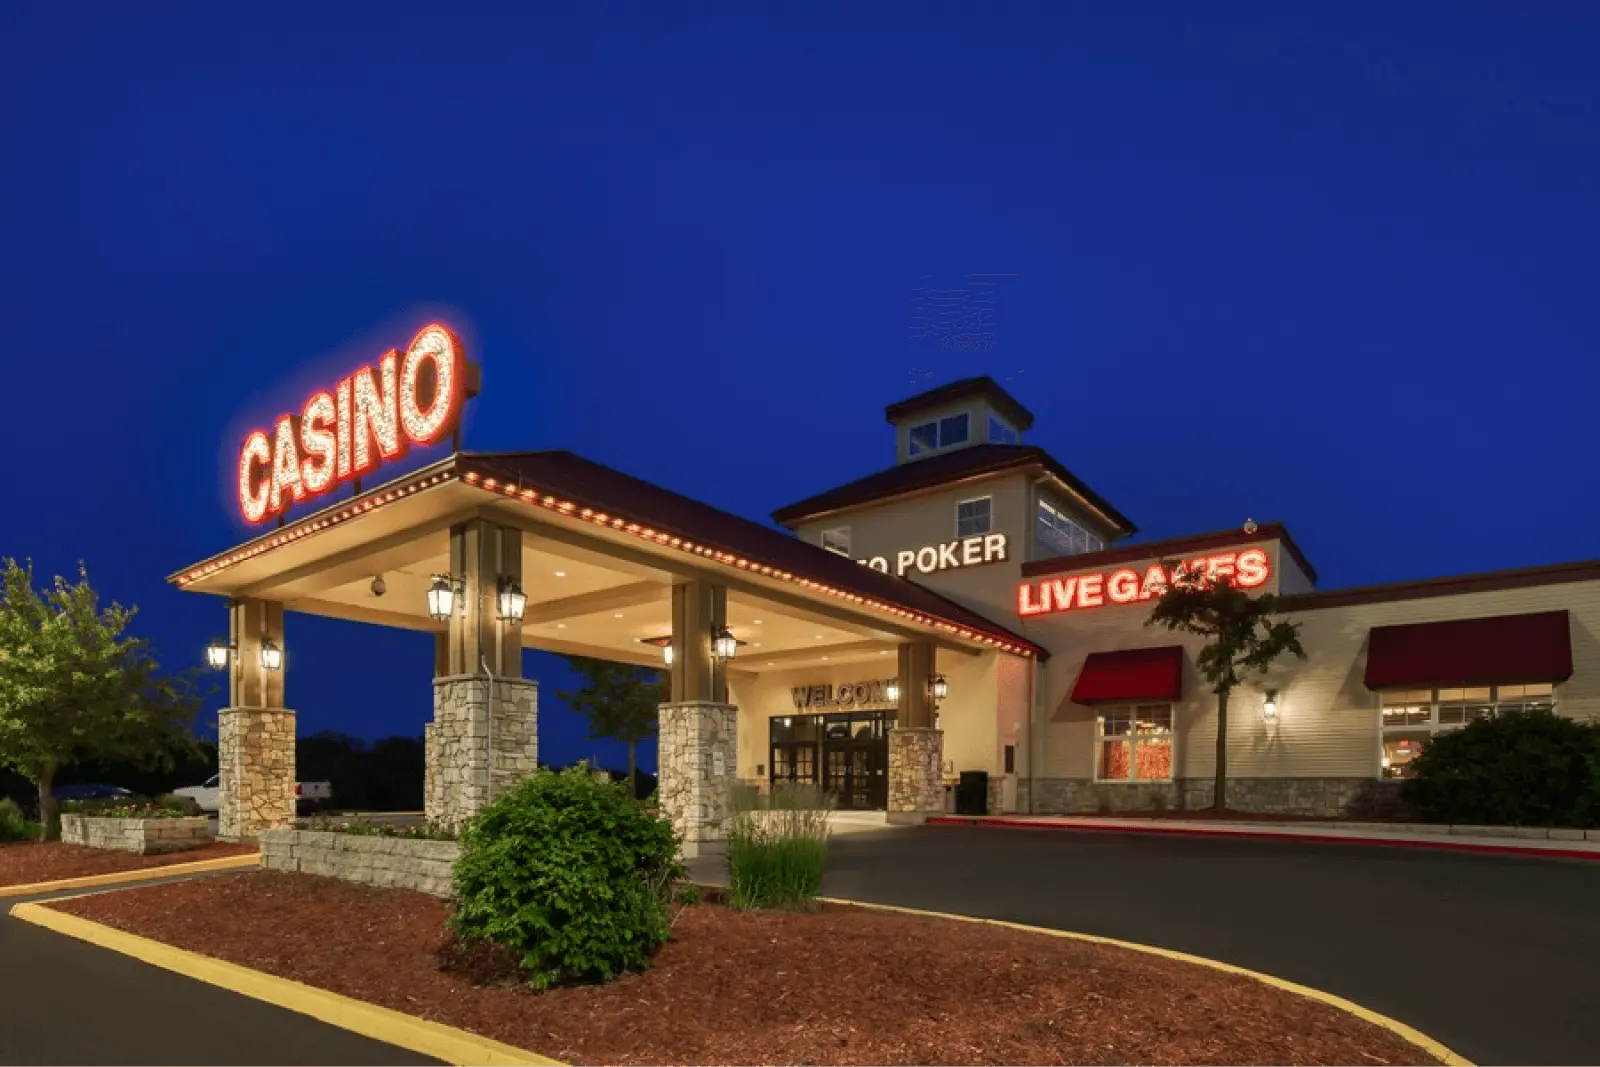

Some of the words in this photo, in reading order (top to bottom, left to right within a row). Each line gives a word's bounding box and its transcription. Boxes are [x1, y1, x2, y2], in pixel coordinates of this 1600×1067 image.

[239, 323, 461, 523] CASINO
[897, 533, 1007, 577] POKER
[1018, 574, 1104, 616] LIVE
[791, 679, 898, 708] WELCOM
